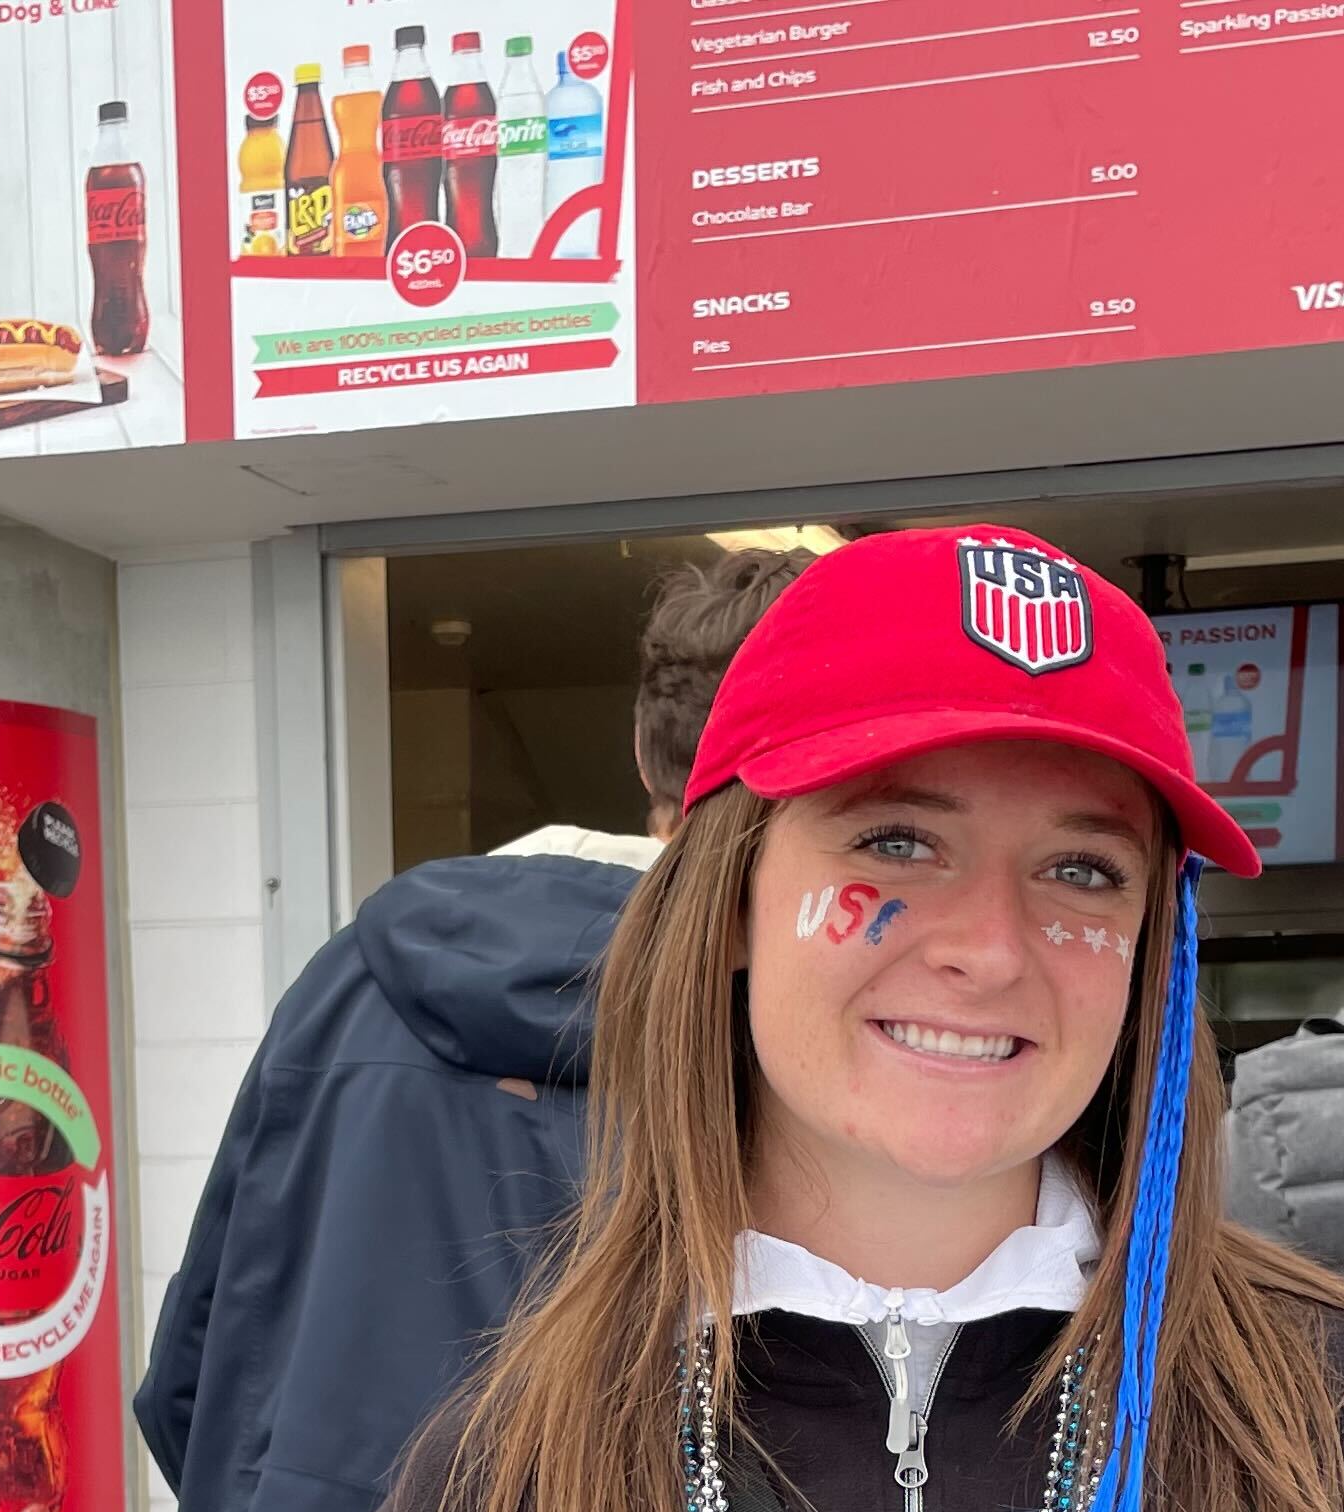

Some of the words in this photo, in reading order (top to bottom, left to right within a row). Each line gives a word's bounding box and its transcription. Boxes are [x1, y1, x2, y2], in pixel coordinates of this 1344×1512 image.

[49, 0, 65, 16] &
[691, 26, 787, 55] Vegetarian
[789, 19, 851, 43] Burger
[1179, 14, 1271, 39] Sparkling
[691, 79, 729, 98] Fish
[730, 72, 765, 92] and
[768, 68, 818, 91] Chips
[1087, 26, 1141, 49] 12.50
[496, 118, 546, 149] Sprite
[692, 156, 820, 190] DESSERTS
[692, 205, 778, 228] Chocolate
[781, 201, 813, 219] Bar
[1090, 162, 1138, 184] 5.00
[693, 291, 791, 319] SNACKS
[273, 339, 303, 356] We
[307, 339, 334, 352] are
[339, 328, 384, 349] 100%
[387, 318, 462, 350] recycled
[465, 311, 525, 341] plastic
[692, 338, 731, 356] Pies
[1090, 297, 1136, 317] 9.50
[337, 359, 431, 387] RECYCLE
[433, 357, 463, 378] US
[463, 352, 530, 374] AGAIN
[973, 549, 1079, 600] USA
[1179, 624, 1277, 645] PASSION
[73, 1286, 95, 1321] ME
[86, 1204, 103, 1280] AGAIN
